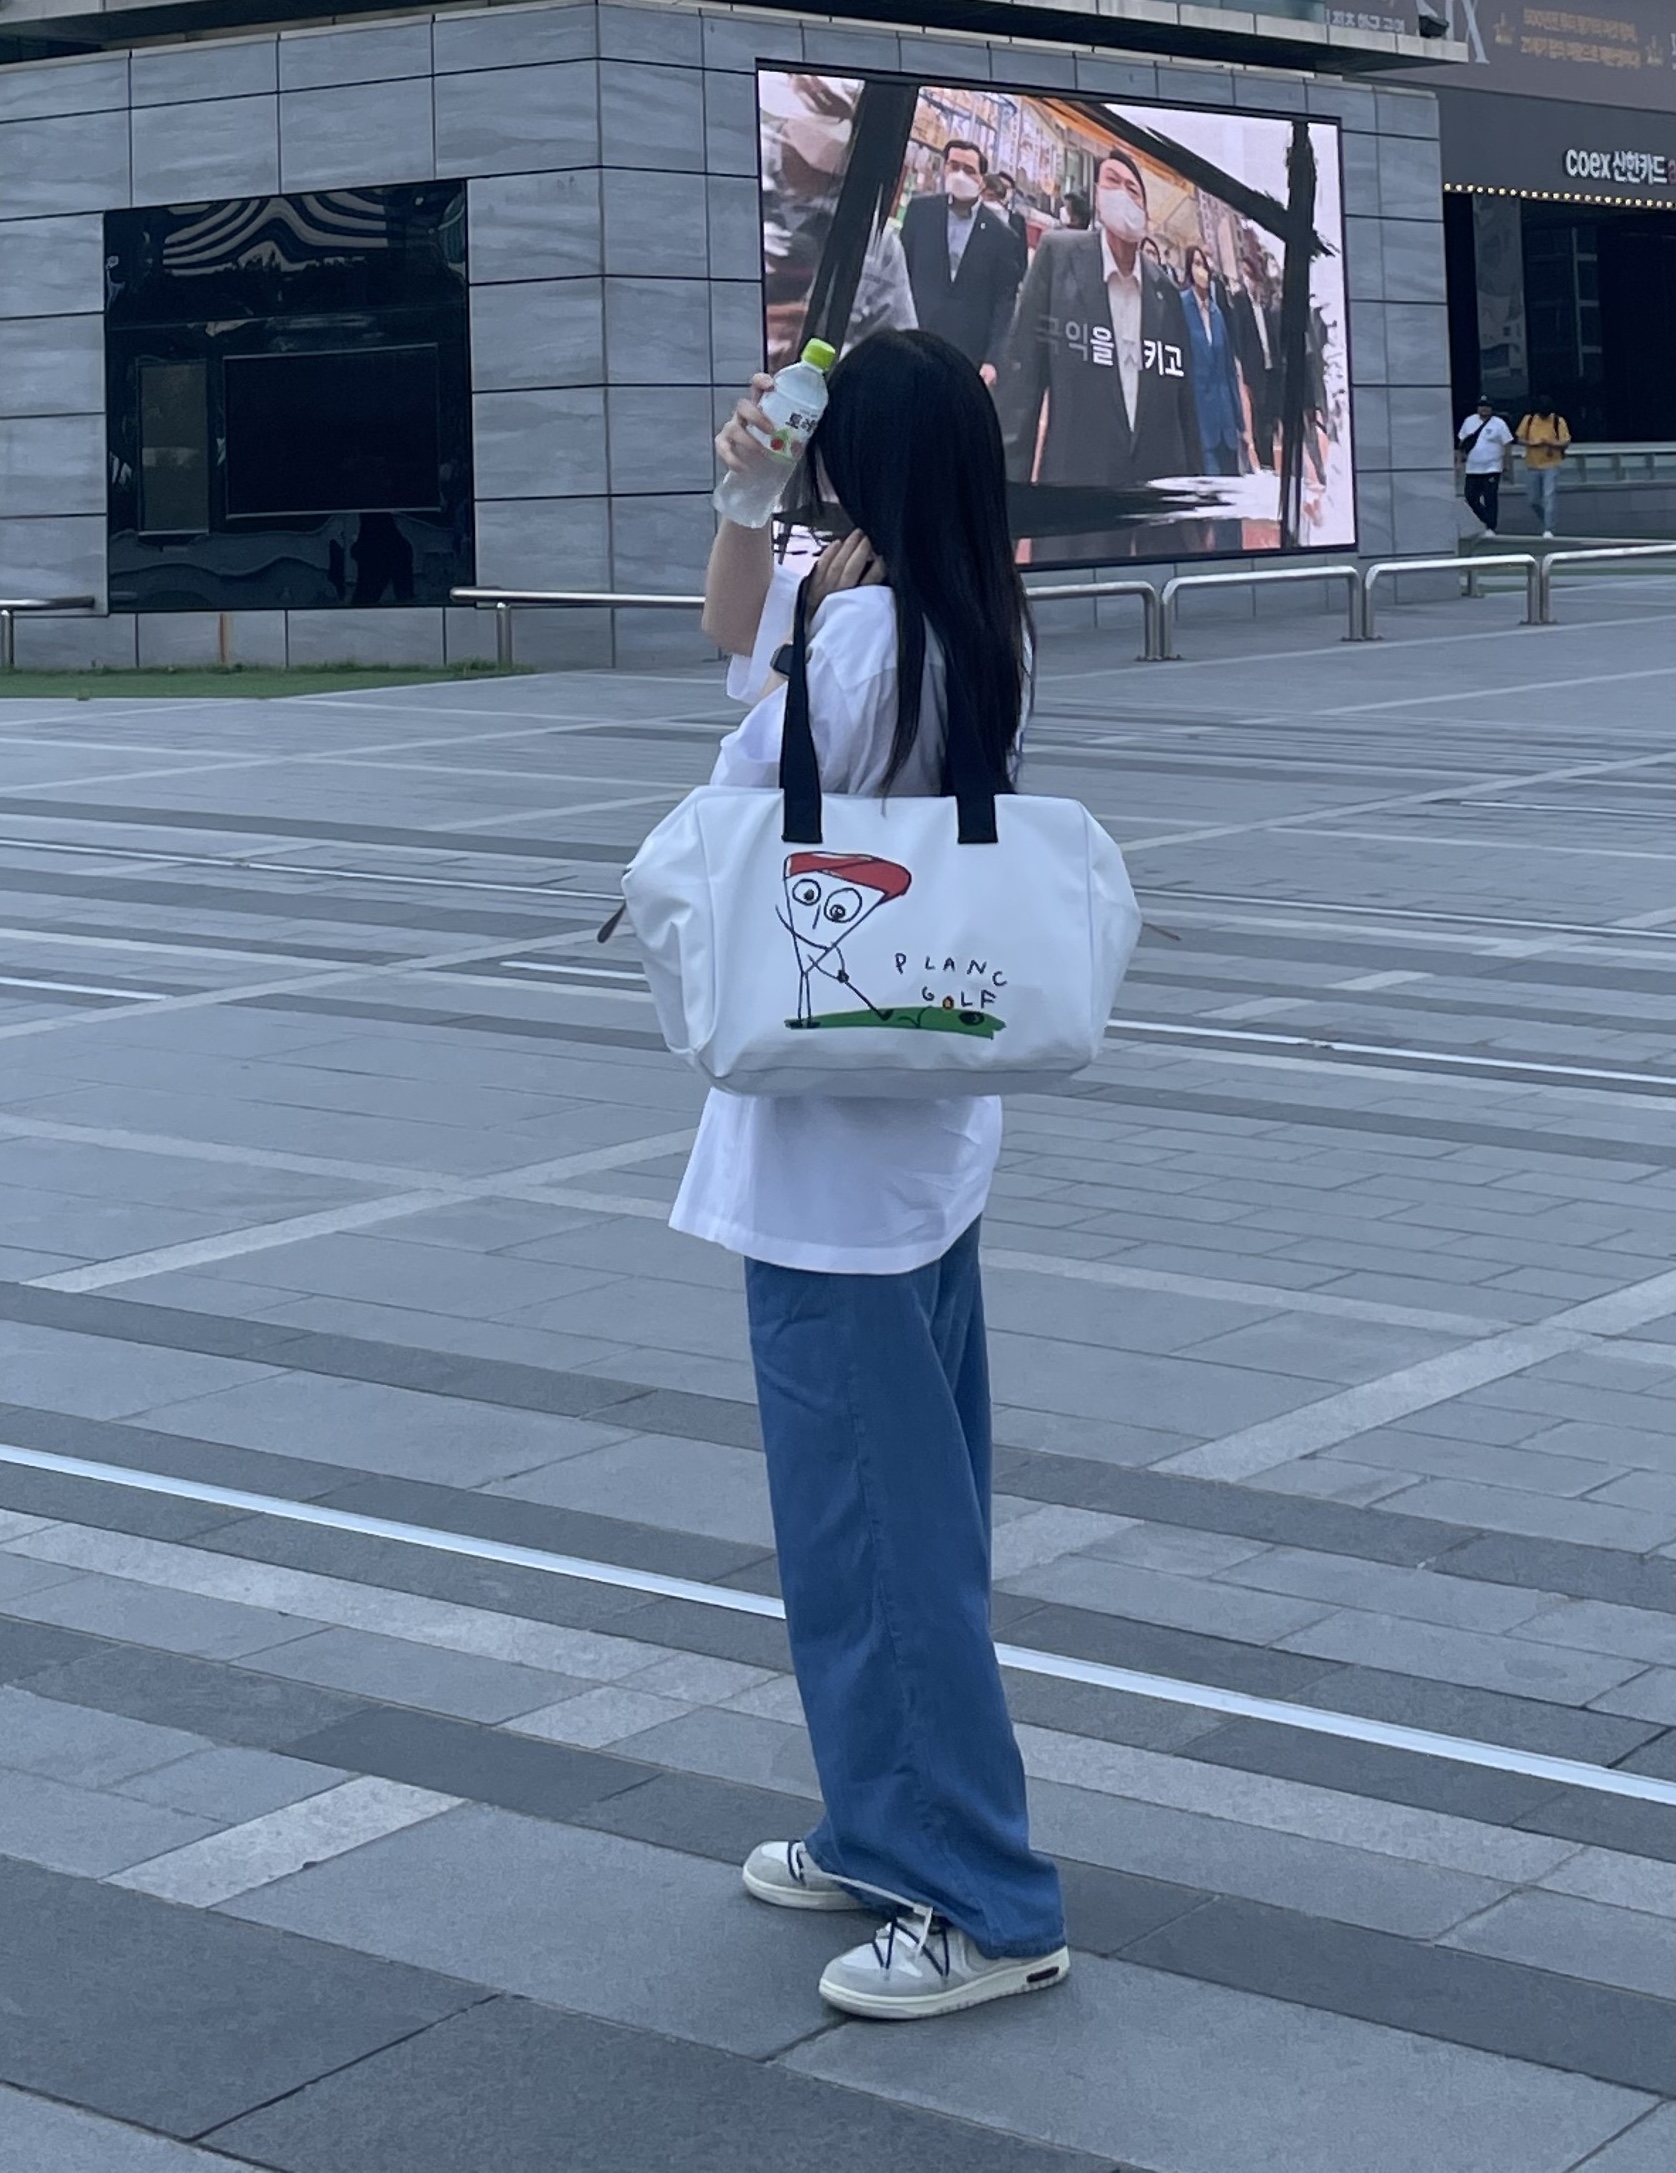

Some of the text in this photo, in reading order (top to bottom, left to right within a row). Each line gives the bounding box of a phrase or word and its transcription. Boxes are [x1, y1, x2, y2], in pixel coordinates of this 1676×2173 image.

[1612, 150, 1668, 185] 신한카드
[1034, 314, 1115, 367] 국익을
[894, 952, 1008, 987] PLANC
[921, 986, 997, 1010] GOLF
